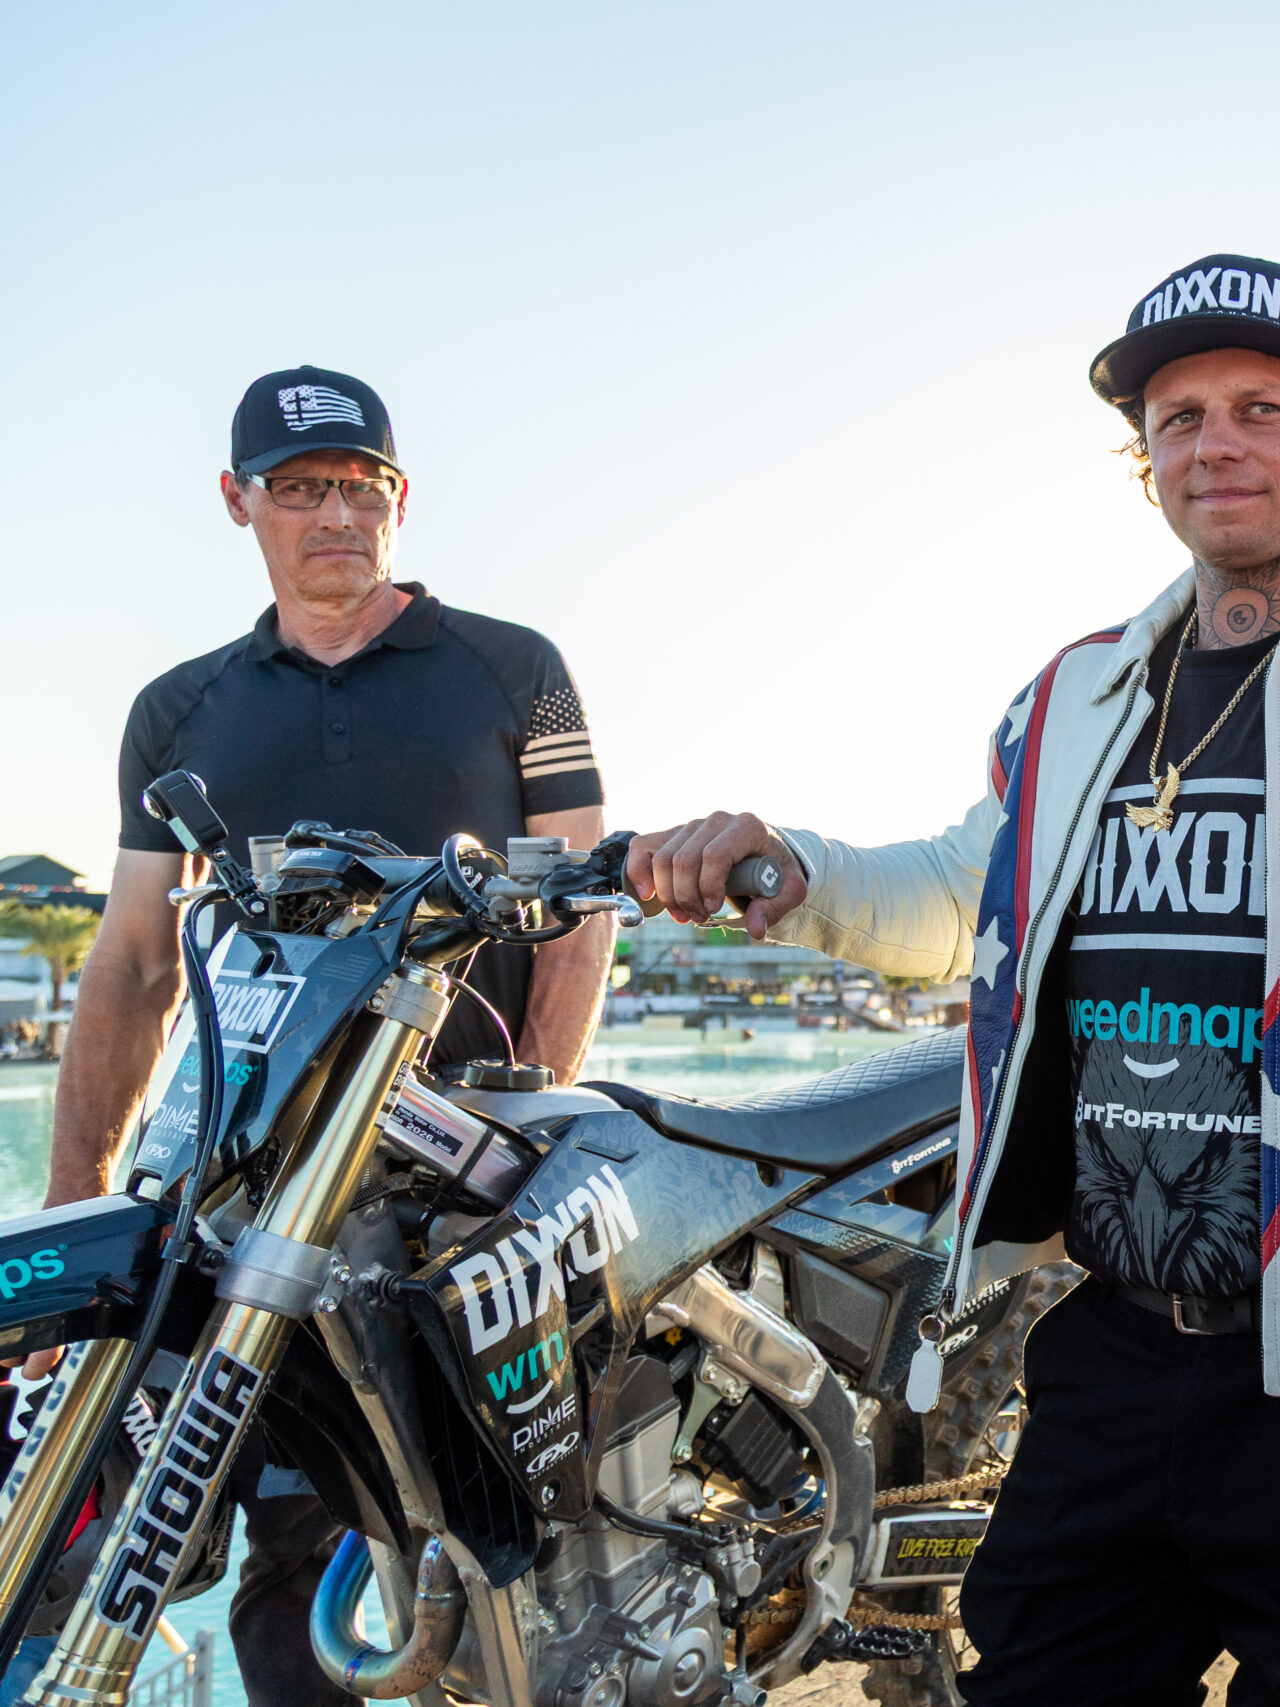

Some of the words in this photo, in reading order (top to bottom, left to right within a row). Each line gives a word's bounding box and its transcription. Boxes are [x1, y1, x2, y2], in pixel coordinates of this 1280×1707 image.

[399, 1107, 413, 1118] Honda
[406, 1122, 434, 1142] 2026
[435, 1140, 452, 1153] Model
[513, 1393, 576, 1451] DIME
[514, 1412, 577, 1457] INDUSTRIES
[94, 1346, 265, 1644] SHOWA
[924, 1538, 956, 1559] FREE
